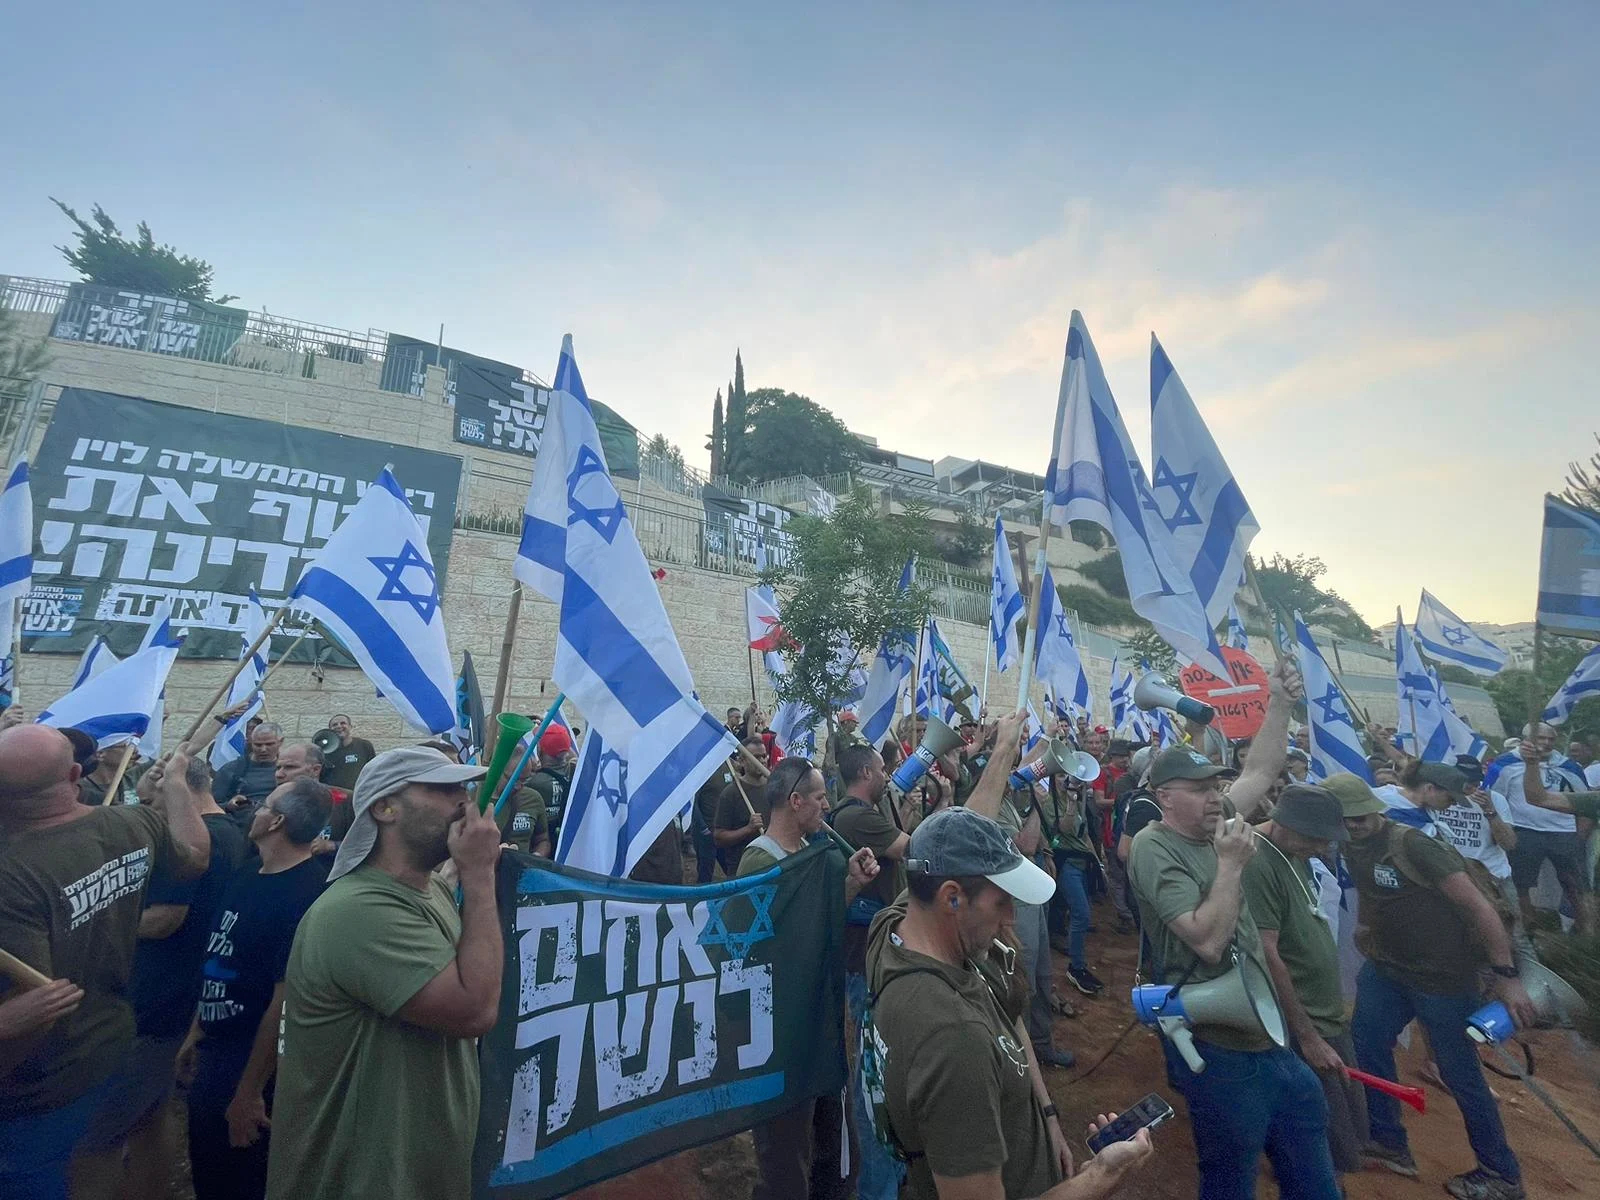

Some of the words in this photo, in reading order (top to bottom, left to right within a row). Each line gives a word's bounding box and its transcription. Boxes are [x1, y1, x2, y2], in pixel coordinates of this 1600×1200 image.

[70, 437, 150, 465] לוין
[157, 448, 346, 495] הממשלה
[48, 465, 219, 526] את
[32, 520, 320, 592] דינה!
[516, 900, 717, 1017] אחים
[502, 958, 775, 1168] לנשק
